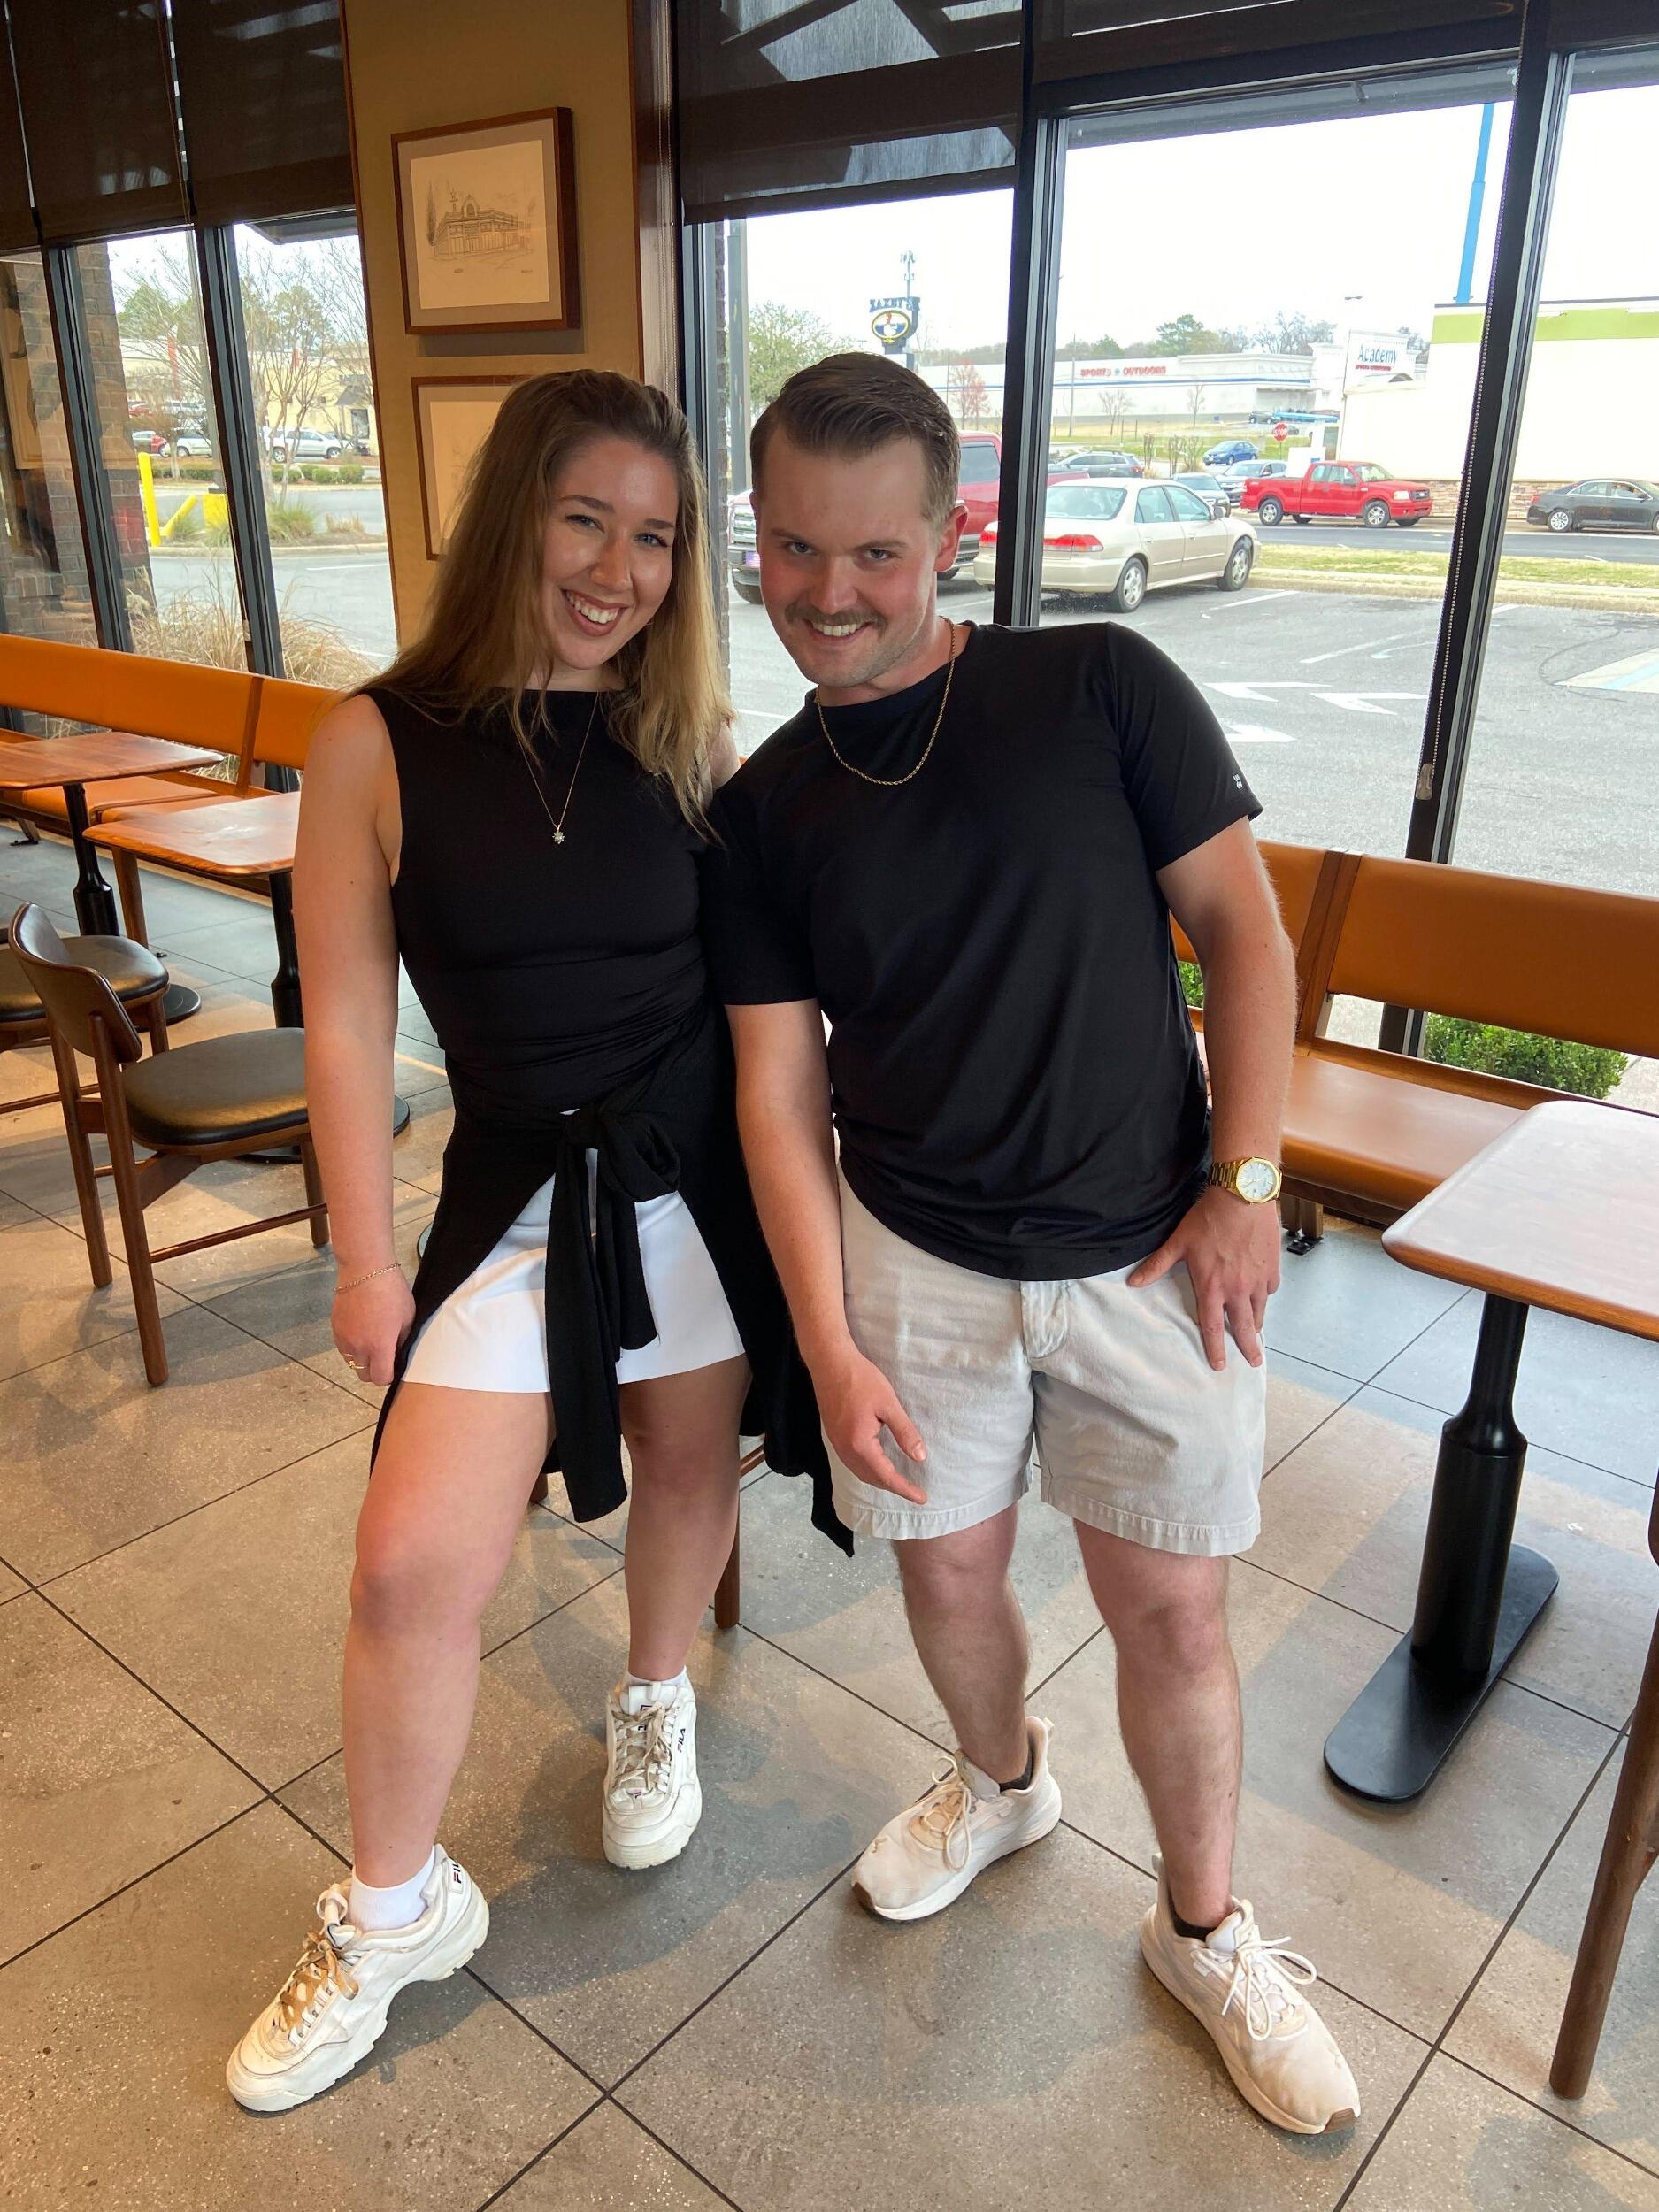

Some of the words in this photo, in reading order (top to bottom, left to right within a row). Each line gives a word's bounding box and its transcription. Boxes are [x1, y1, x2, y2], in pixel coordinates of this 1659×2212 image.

[1357, 344, 1398, 365] Academy
[1123, 366, 1166, 375] OUTDOORS
[677, 1728, 686, 1752] FILA
